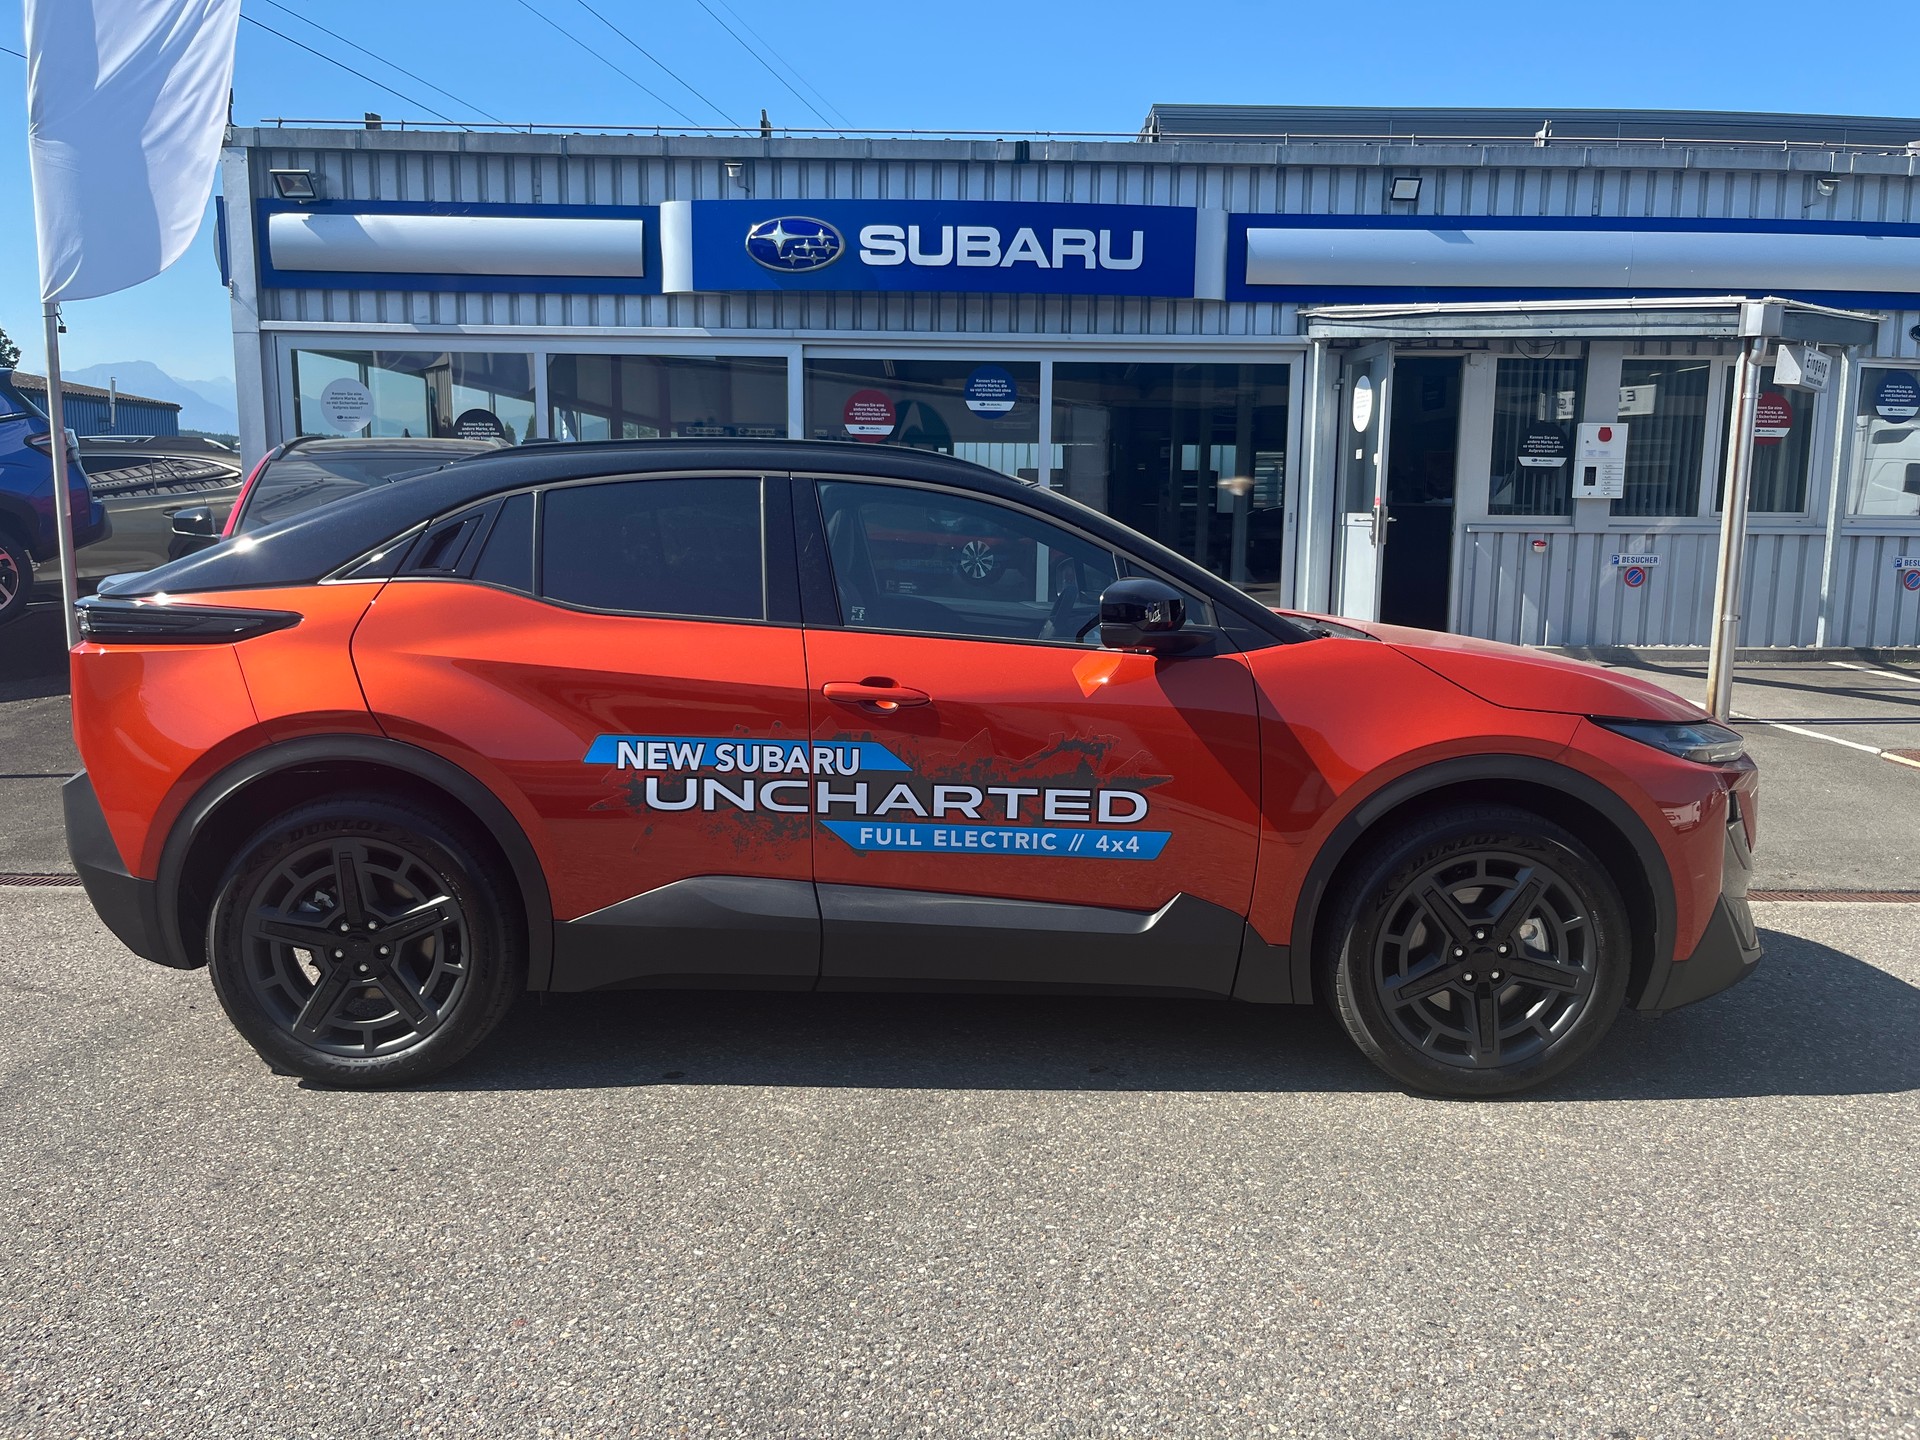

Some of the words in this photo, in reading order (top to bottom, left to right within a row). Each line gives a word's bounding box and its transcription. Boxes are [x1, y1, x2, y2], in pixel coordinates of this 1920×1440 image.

[859, 224, 1144, 270] SUBARU
[1806, 353, 1828, 378] Eingang
[617, 741, 706, 771] NEW
[714, 743, 861, 776] SUBARU
[644, 776, 1149, 824] UNCHARTED
[290, 818, 391, 840] DUNLOP
[860, 827, 922, 846] FULL
[933, 829, 1057, 850] ELECTRIC
[1095, 834, 1140, 853] 4x4
[1412, 835, 1508, 869] DUNLOP
